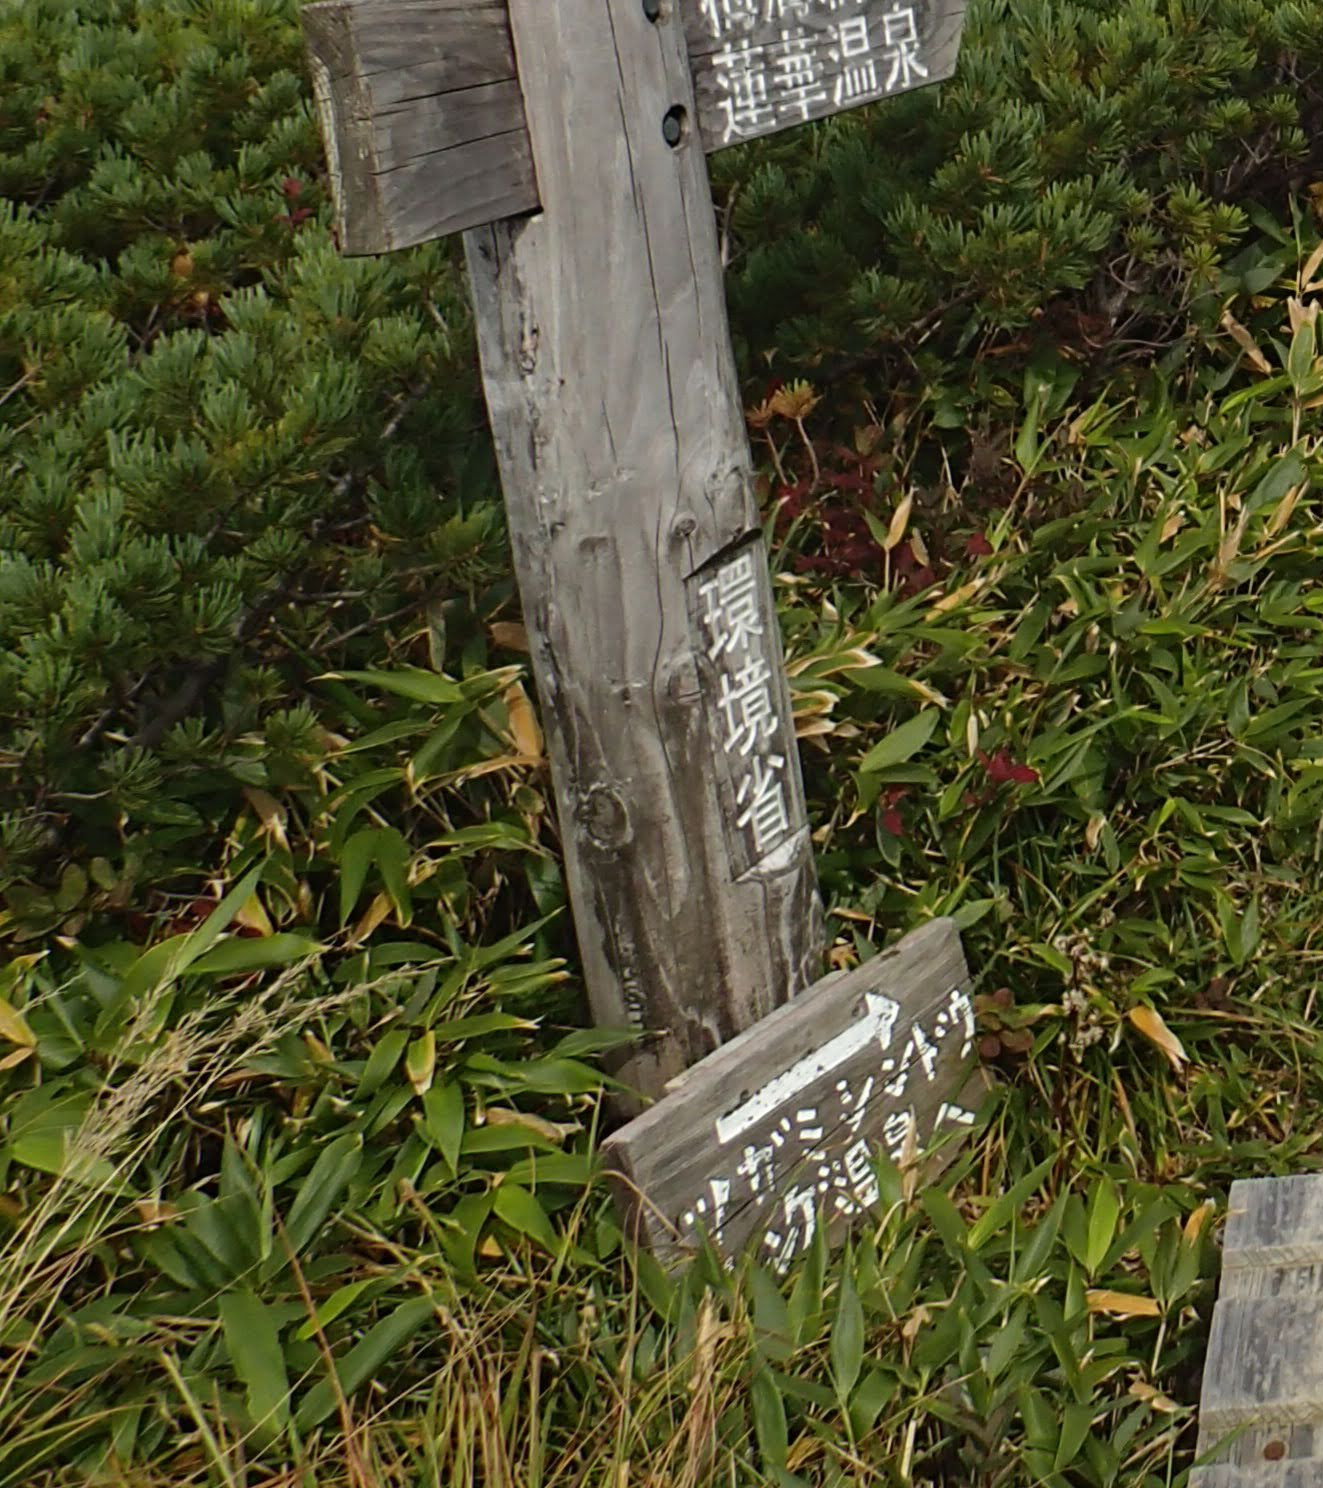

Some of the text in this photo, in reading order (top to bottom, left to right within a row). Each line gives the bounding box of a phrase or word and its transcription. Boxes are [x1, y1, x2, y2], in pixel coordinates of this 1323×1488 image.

[711, 2, 929, 144] 蓮華温泉
[698, 553, 789, 853] 環境省
